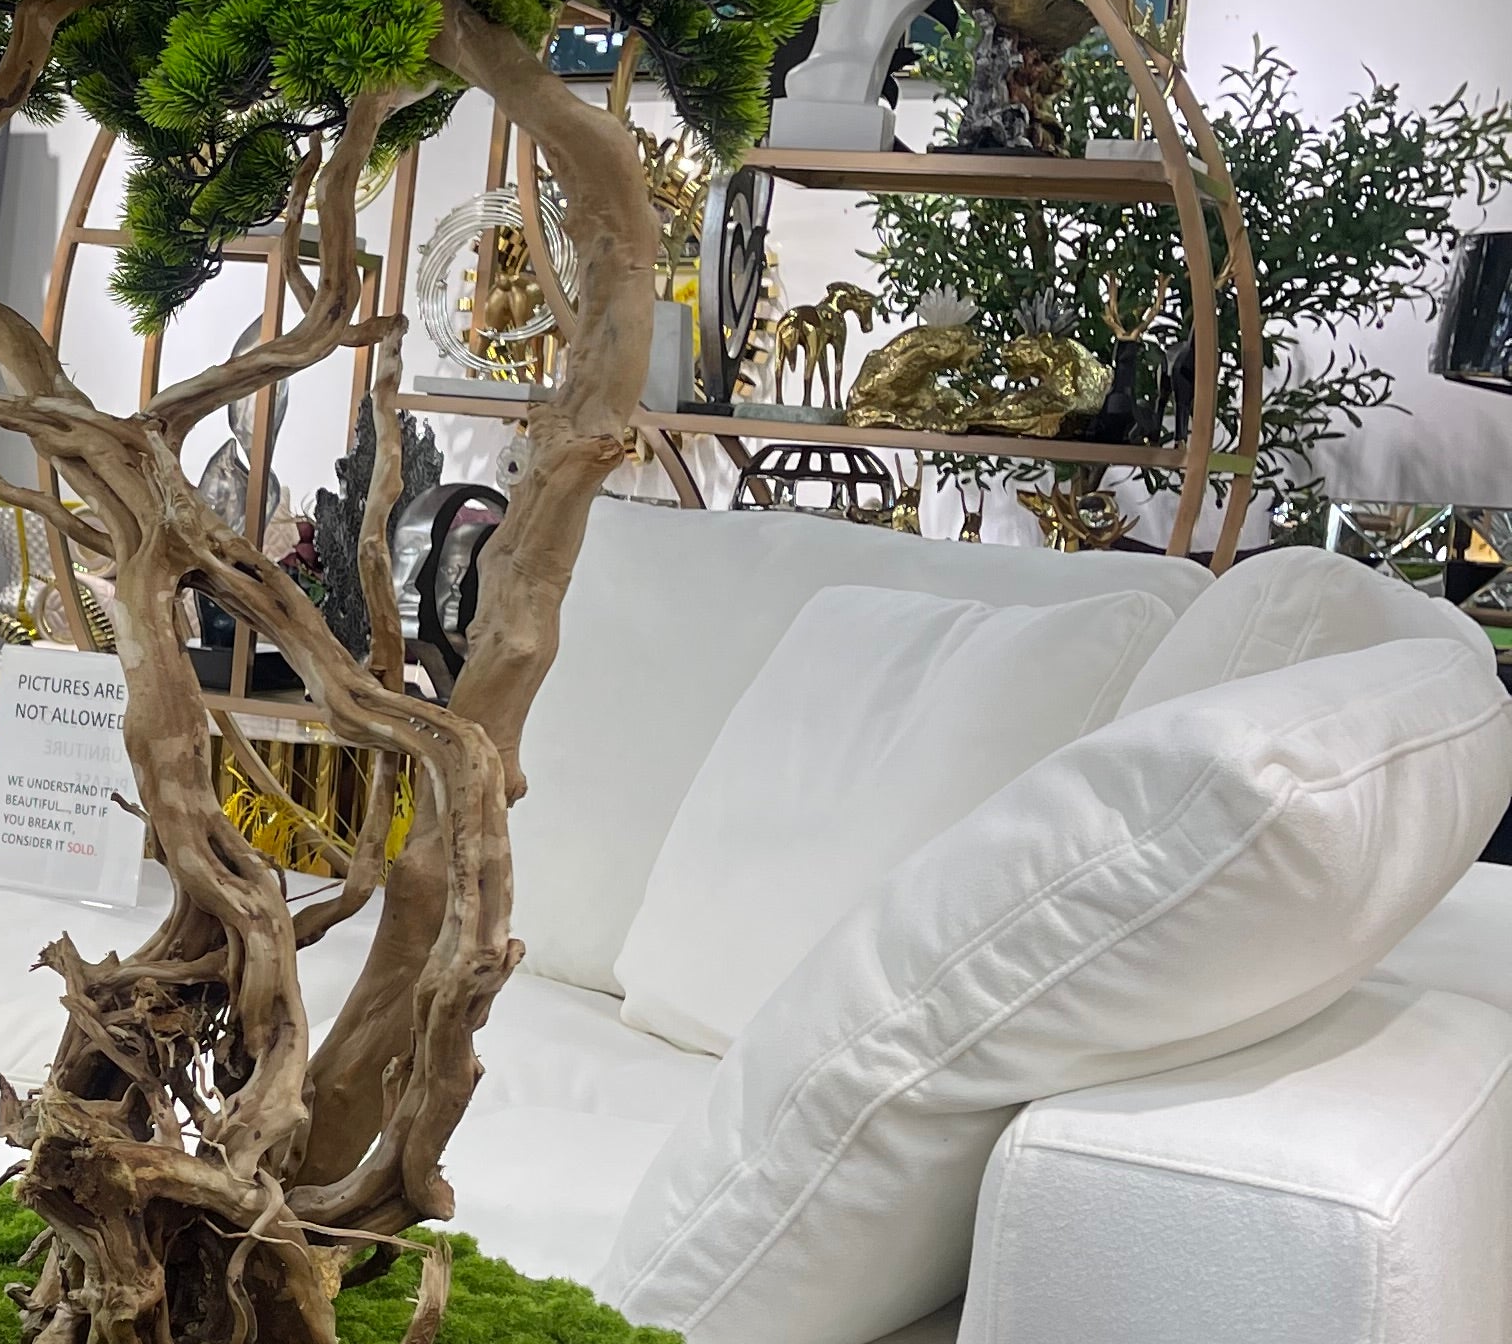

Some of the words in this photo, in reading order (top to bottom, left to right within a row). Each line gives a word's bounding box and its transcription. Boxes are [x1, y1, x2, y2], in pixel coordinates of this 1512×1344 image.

[18, 674, 89, 697] PICTURES
[94, 683, 125, 700] ARE
[15, 703, 48, 720] NOT
[8, 775, 24, 787] WE
[27, 778, 98, 797] UNDERSTAND
[75, 803, 97, 816] BUT
[99, 806, 108, 817] IF
[3, 814, 25, 826] YOU
[28, 817, 61, 831] BREAK
[64, 822, 75, 835] IT,
[1, 832, 52, 851] CONSIDER
[55, 840, 65, 851] IT
[67, 842, 98, 856] SOLD.
